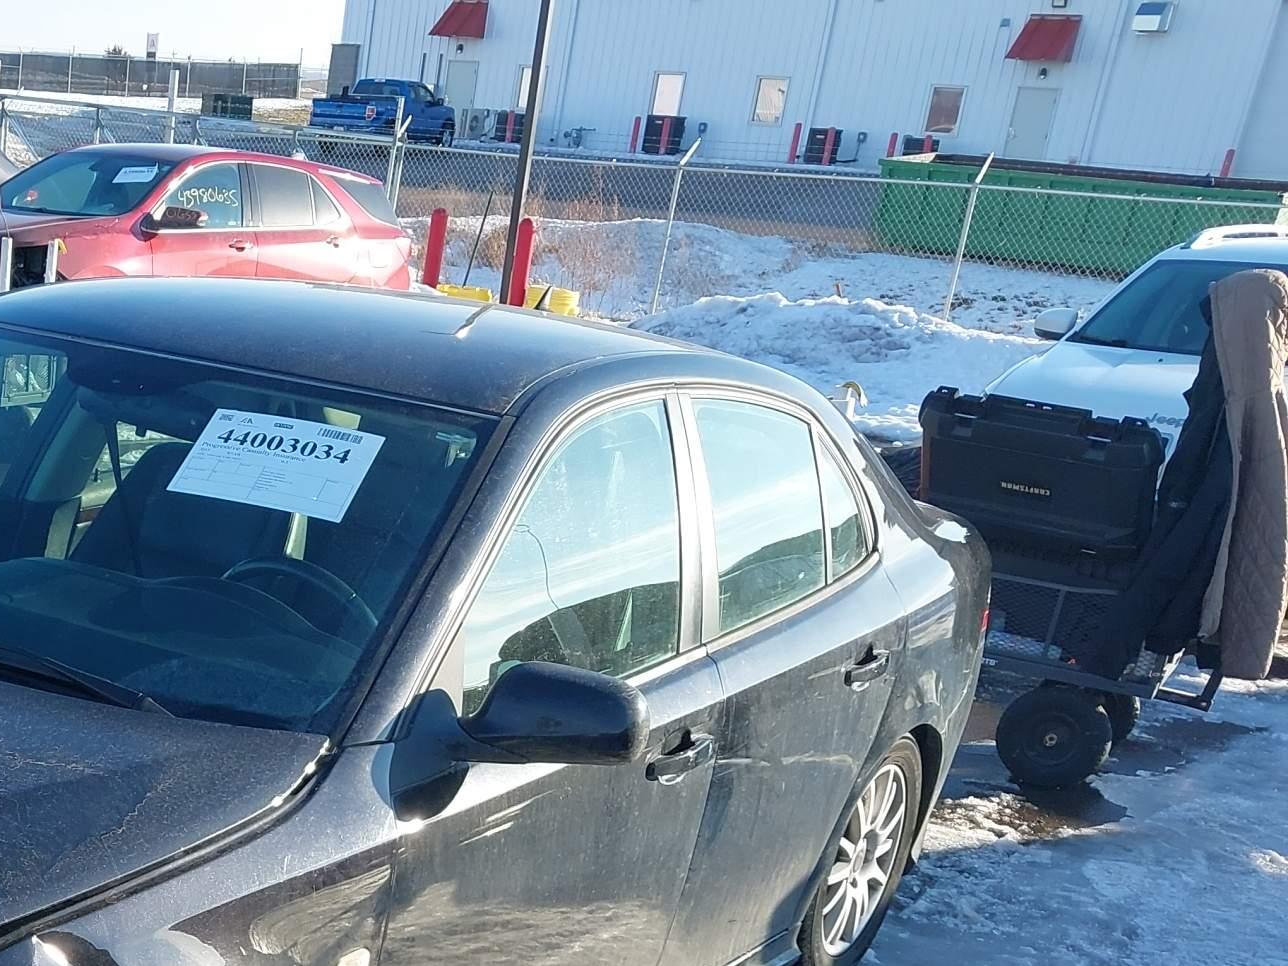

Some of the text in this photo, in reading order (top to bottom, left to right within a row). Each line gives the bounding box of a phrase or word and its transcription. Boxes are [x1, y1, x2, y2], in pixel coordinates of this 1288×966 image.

[201, 441, 241, 452] Progressive
[241, 446, 271, 456] Casualty
[272, 452, 307, 462] Insurance
[217, 428, 352, 464] 44003034
